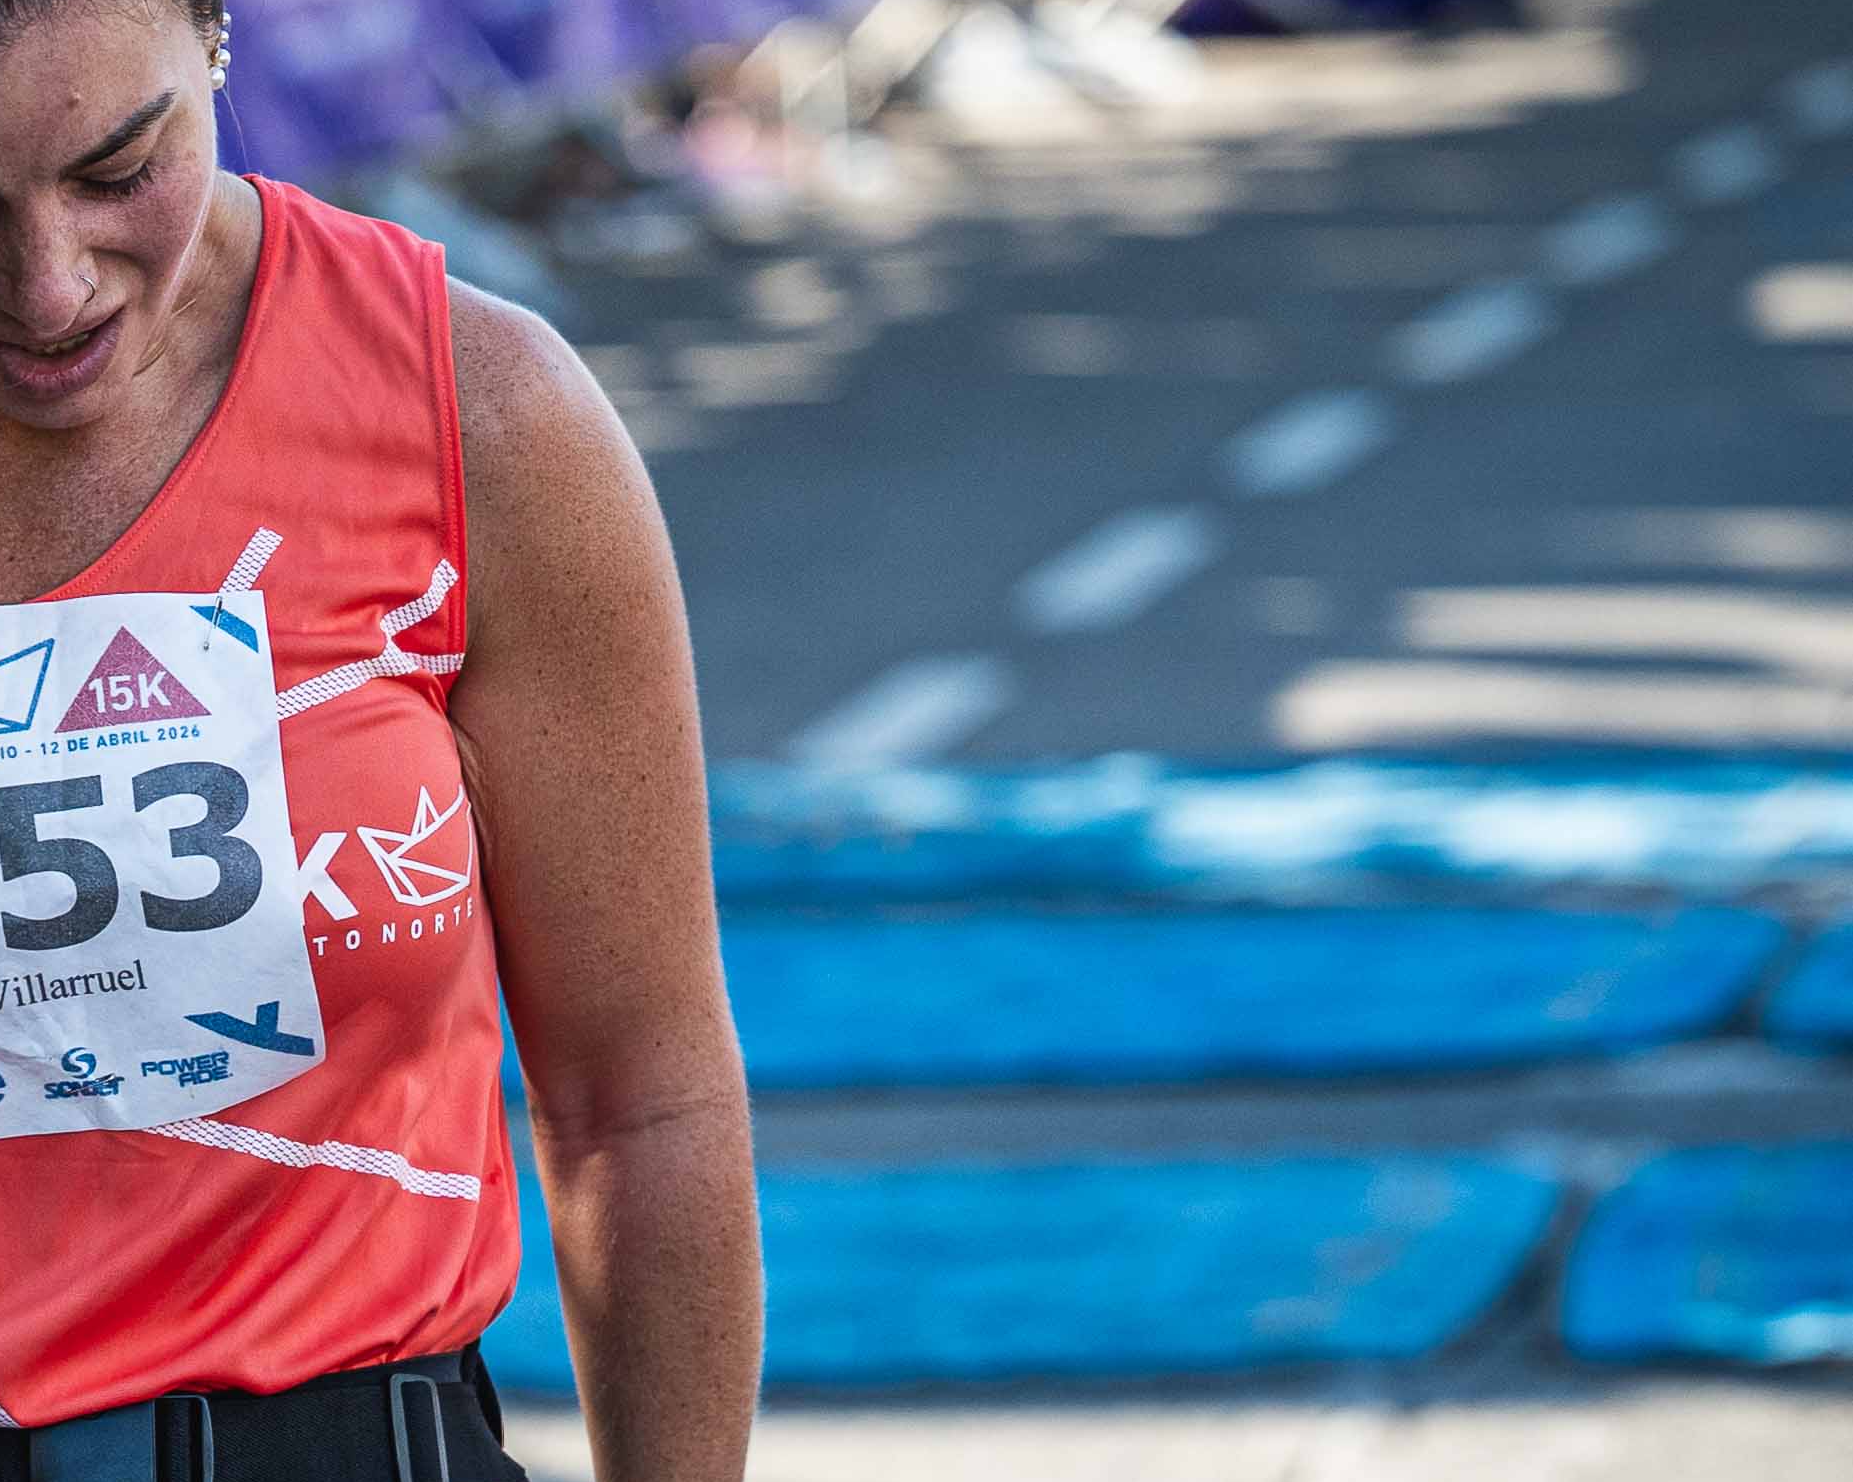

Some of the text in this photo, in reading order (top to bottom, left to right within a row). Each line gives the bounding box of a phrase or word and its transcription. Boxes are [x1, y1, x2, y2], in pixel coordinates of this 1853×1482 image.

[88, 669, 171, 715] 15K
[41, 741, 59, 756] 12
[67, 736, 89, 753] DE
[97, 729, 150, 749] ABRIL
[157, 724, 200, 741] 2026
[381, 896, 474, 944] NORTE
[140, 1050, 230, 1078] POWER
